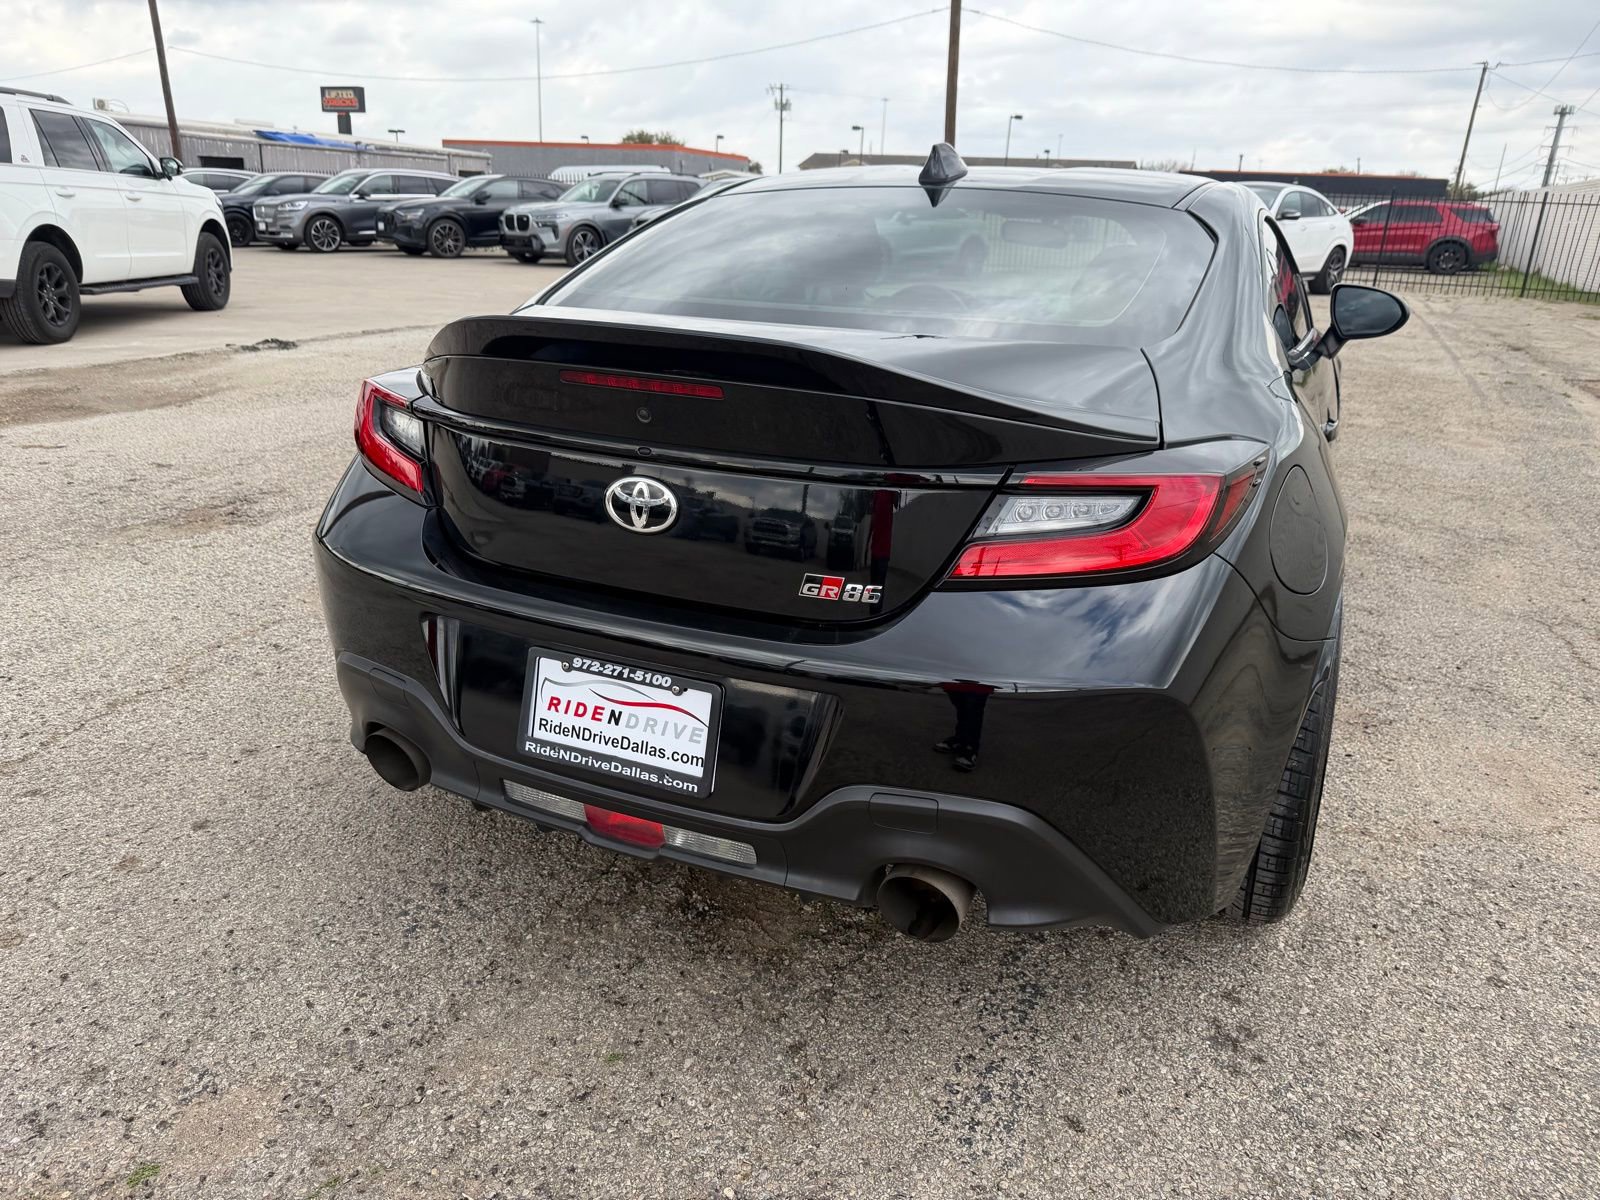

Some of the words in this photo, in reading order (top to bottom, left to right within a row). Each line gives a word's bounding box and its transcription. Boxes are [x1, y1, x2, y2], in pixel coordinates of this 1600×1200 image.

[572, 657, 672, 688] 972-271-5100
[525, 741, 698, 793] RideNDriveDallas.com
[538, 718, 704, 768] RideNDriveDallas.com
